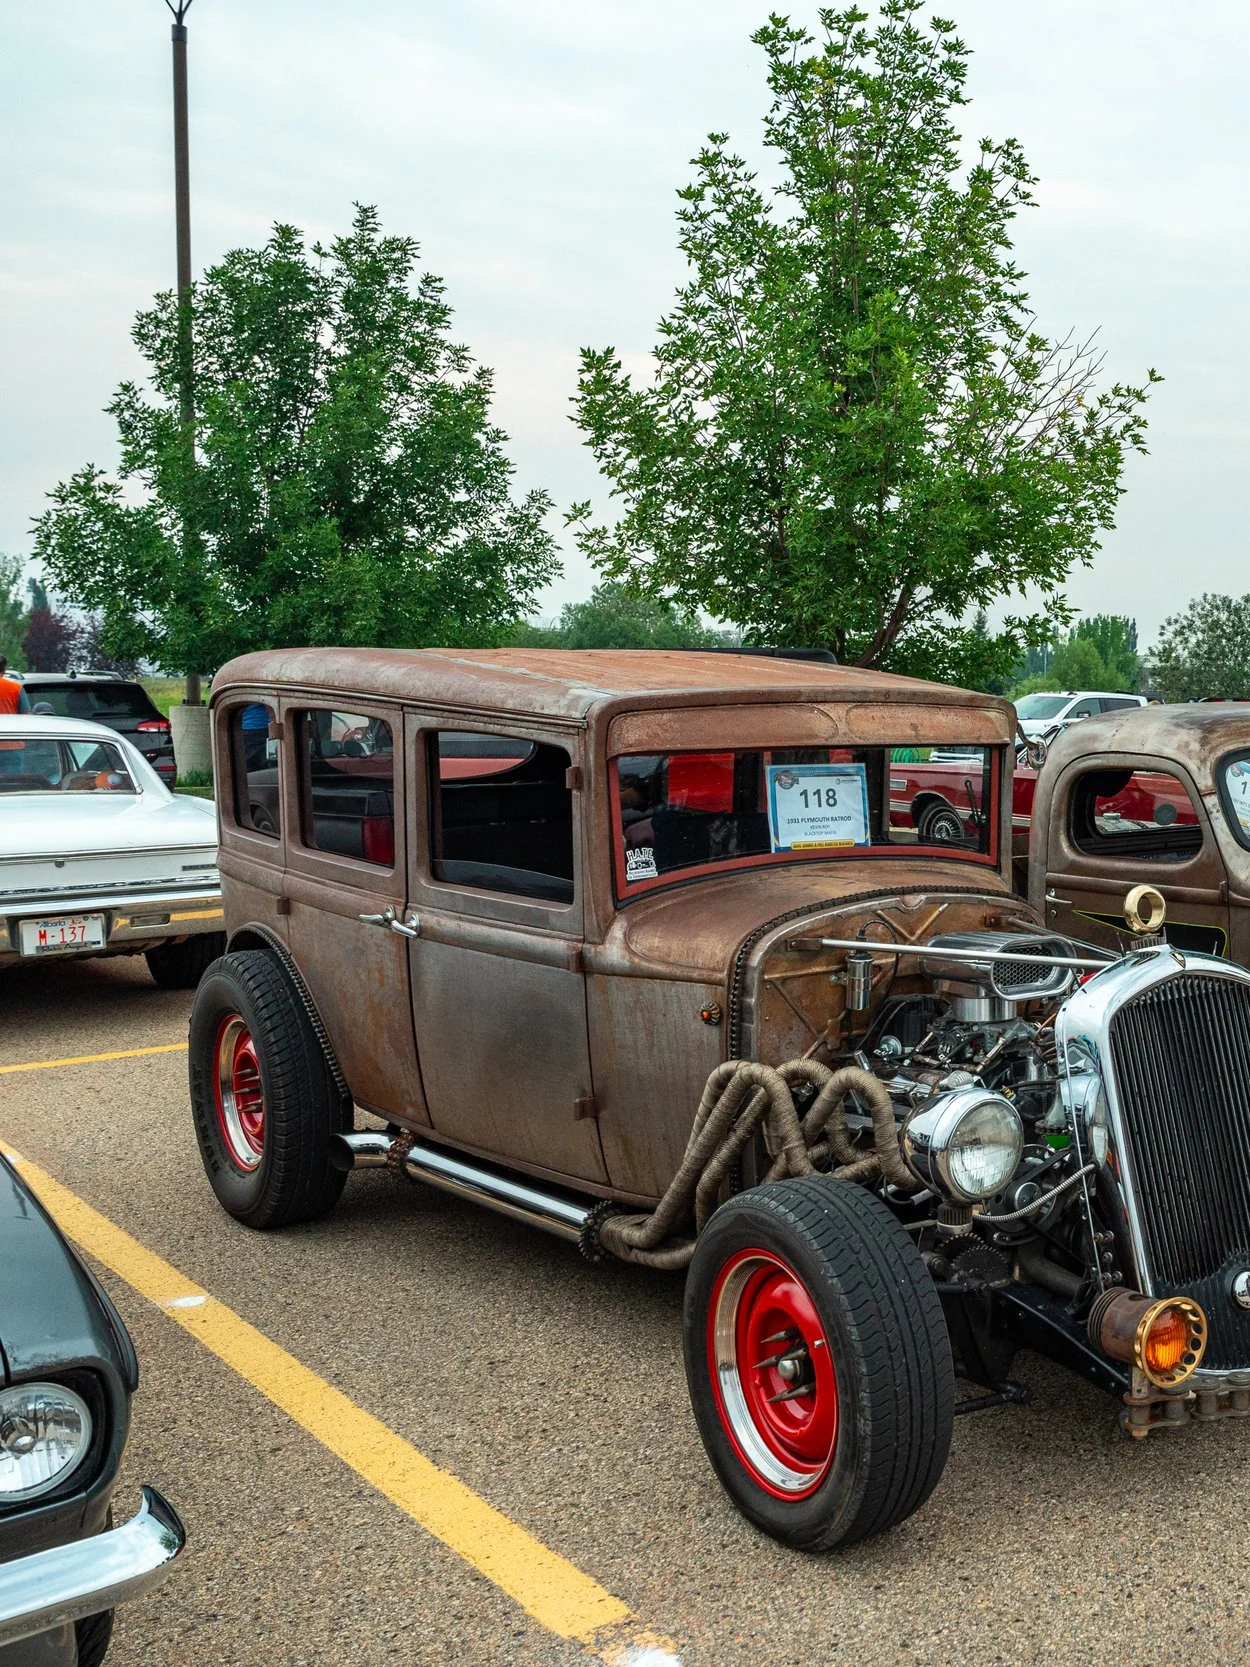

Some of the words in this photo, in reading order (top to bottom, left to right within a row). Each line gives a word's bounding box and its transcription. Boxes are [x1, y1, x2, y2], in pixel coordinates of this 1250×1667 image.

[799, 788, 838, 809] 118
[626, 848, 654, 861] HATE
[39, 926, 86, 945] M-137
